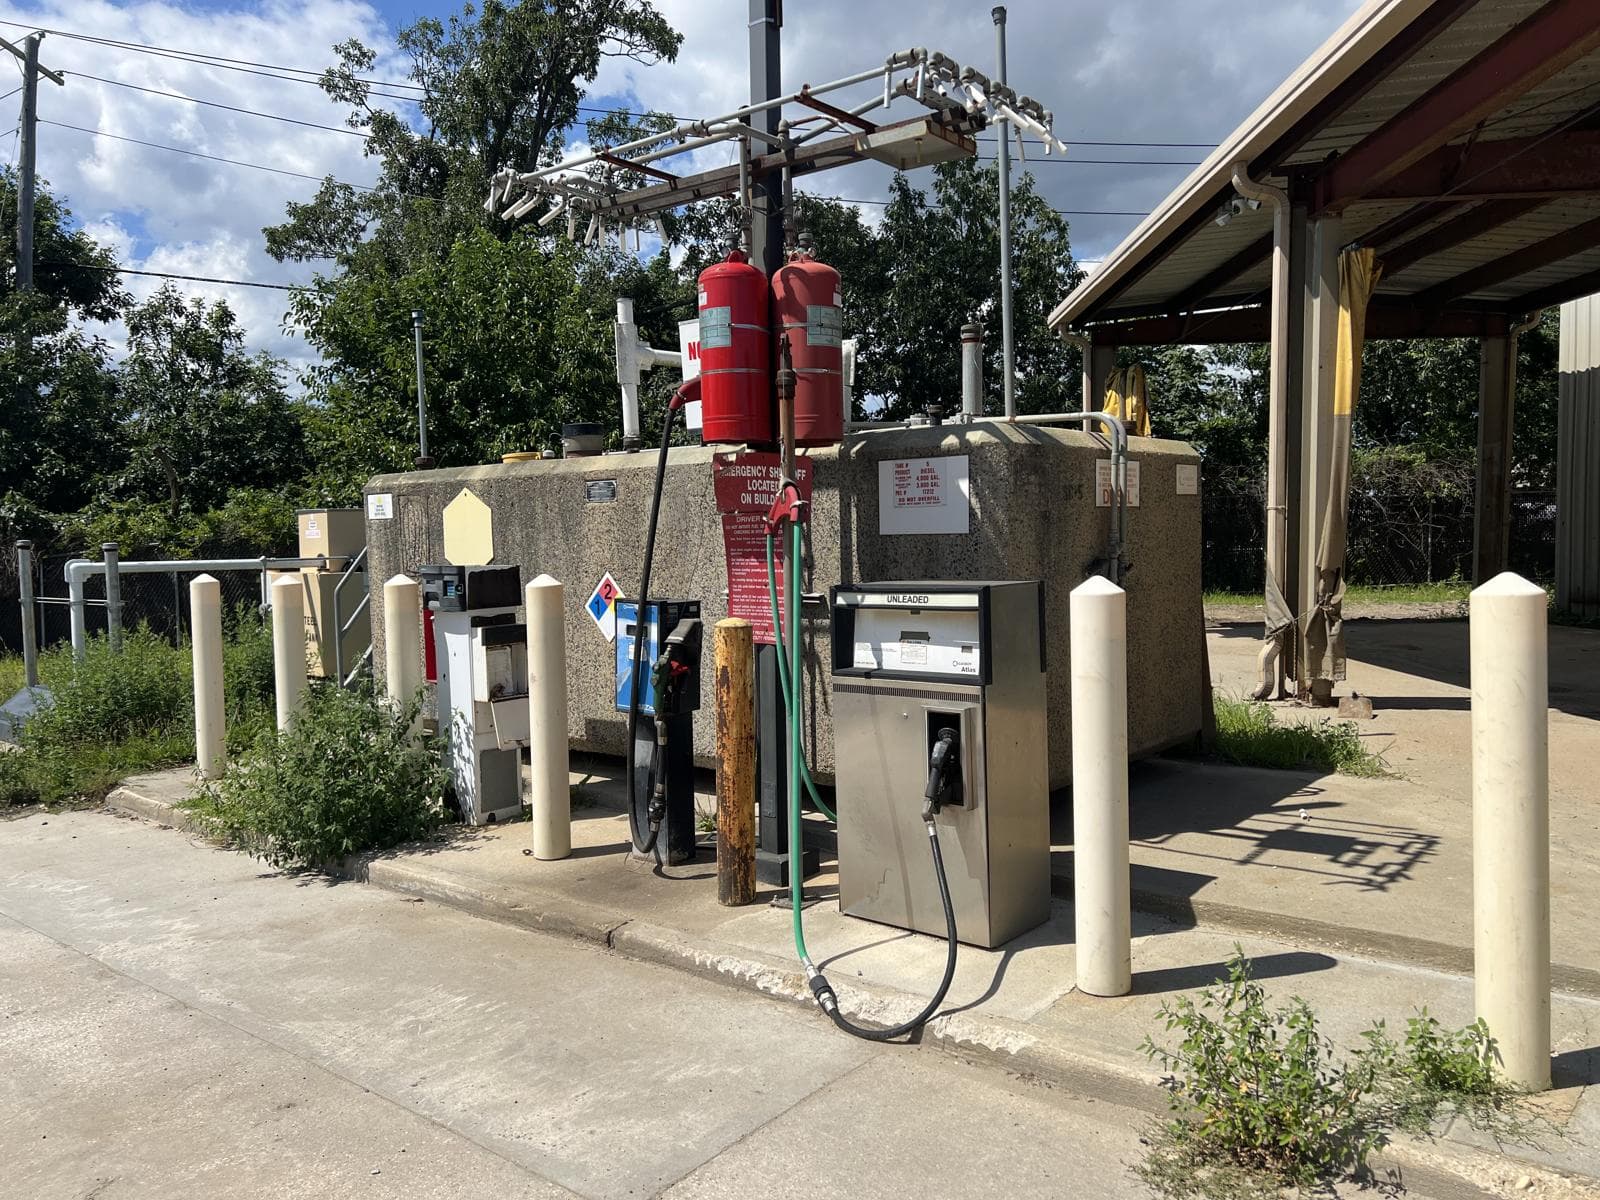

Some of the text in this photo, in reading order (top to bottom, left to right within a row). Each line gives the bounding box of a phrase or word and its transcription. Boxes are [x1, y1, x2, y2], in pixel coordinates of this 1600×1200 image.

[722, 465, 767, 477] ERGENCY
[740, 493, 776, 506] ON BUILD
[603, 583, 613, 600] 2
[886, 594, 929, 604] UNLEADED
[594, 600, 601, 616] 1
